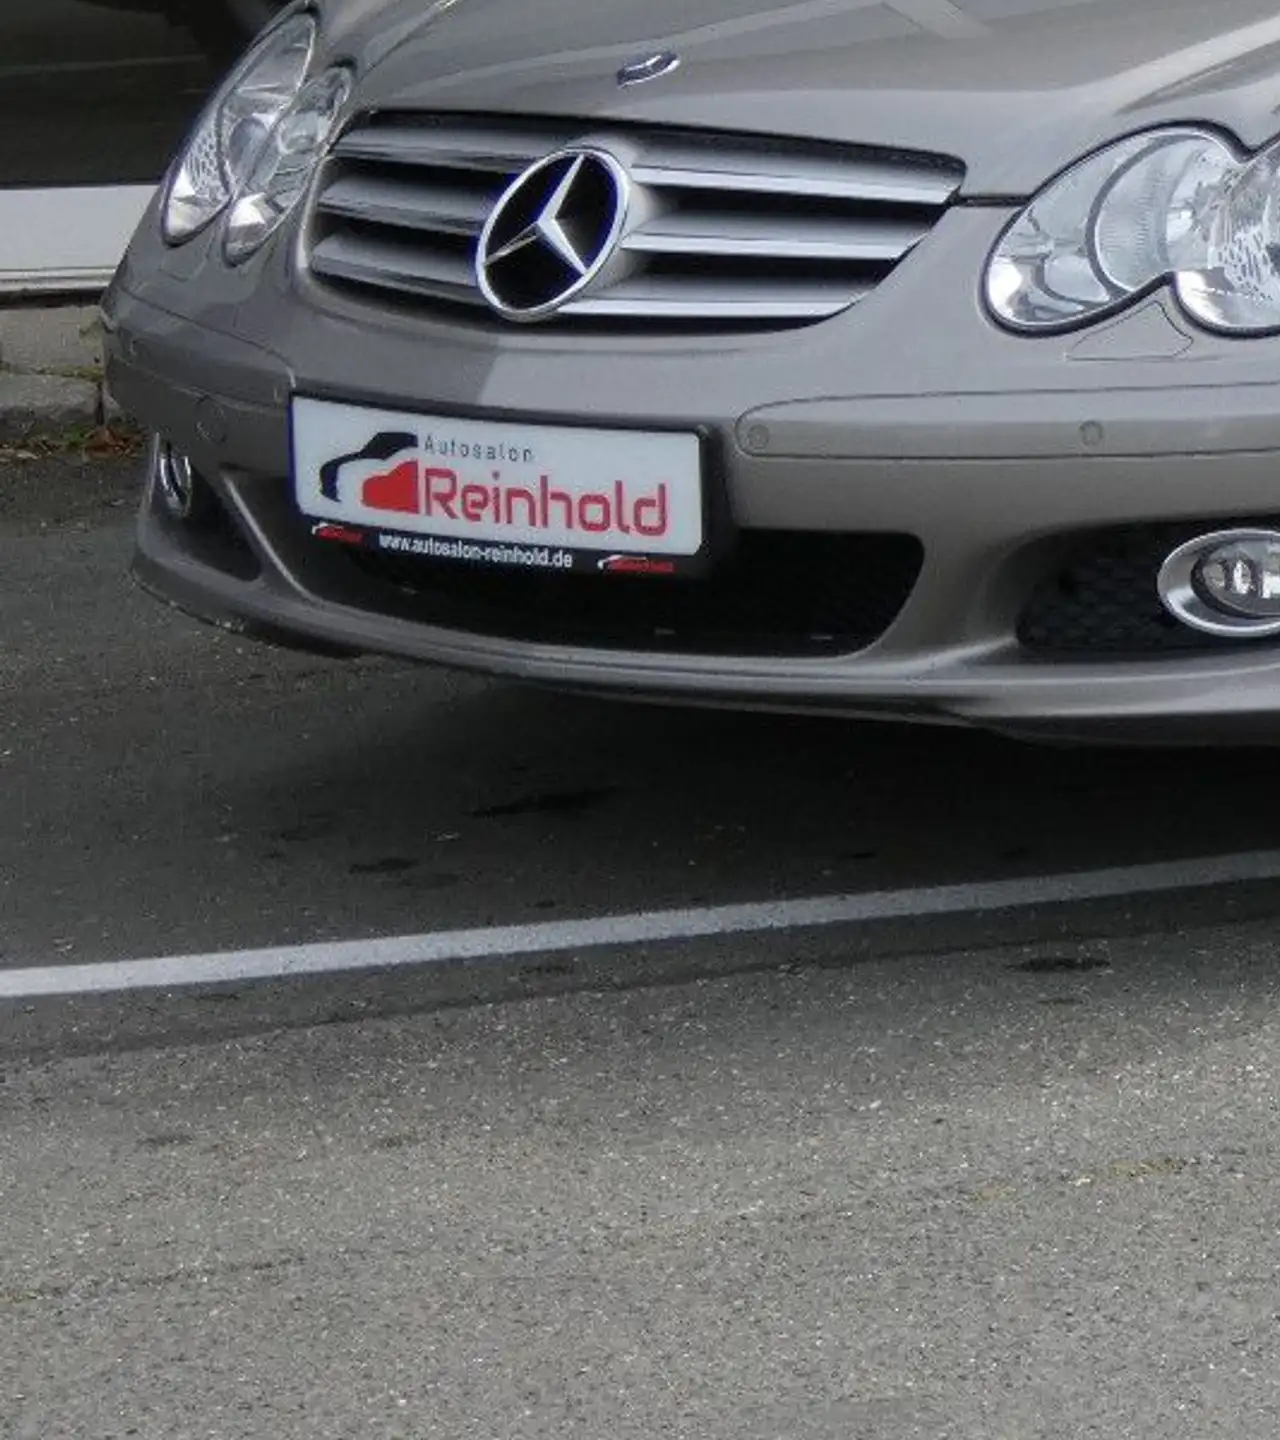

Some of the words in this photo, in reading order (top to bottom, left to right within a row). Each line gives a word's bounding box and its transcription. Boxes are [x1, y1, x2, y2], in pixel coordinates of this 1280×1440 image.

[424, 433, 533, 463] Autosalon
[424, 465, 668, 537] Reinhold
[378, 533, 574, 568] www.autosalon-reinhold.de
